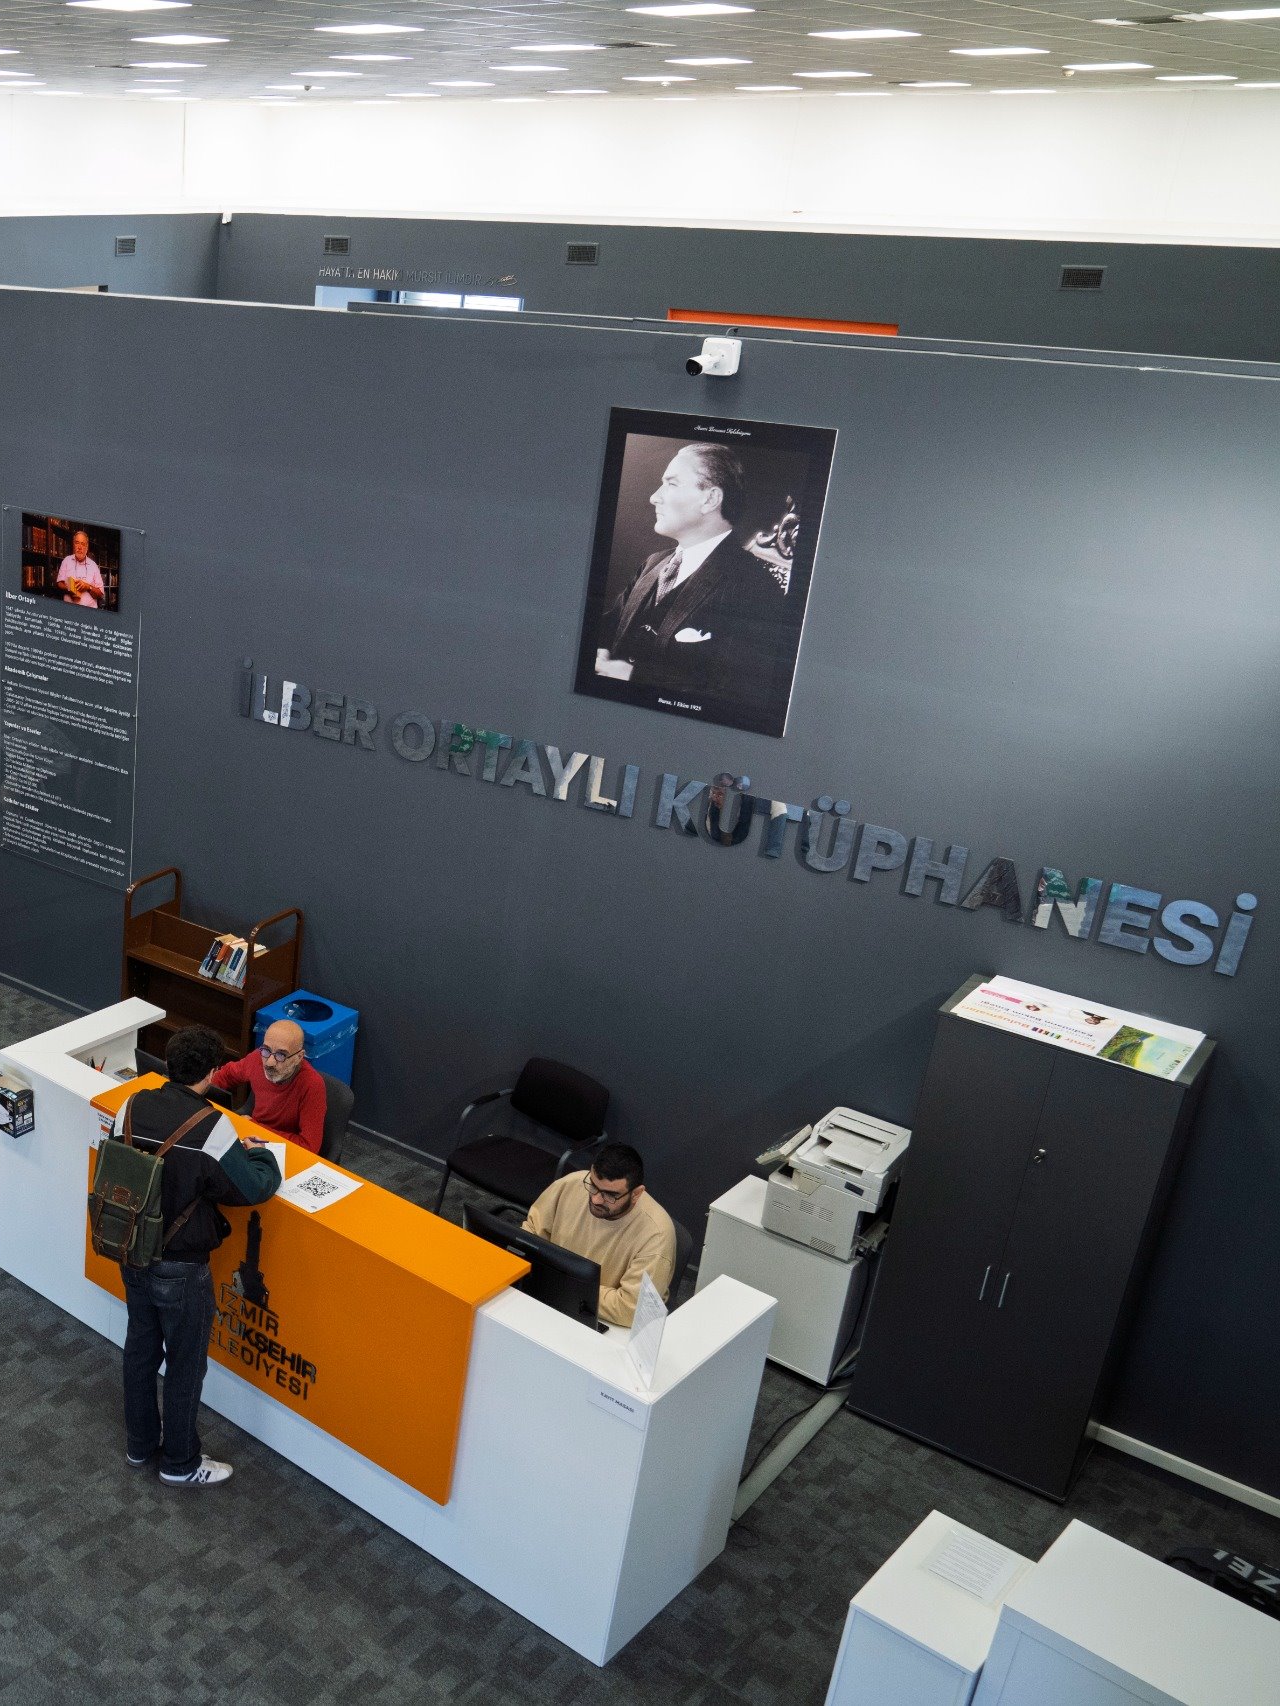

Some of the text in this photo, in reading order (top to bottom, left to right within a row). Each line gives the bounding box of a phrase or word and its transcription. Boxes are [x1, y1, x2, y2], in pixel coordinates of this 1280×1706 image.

[357, 268, 370, 279] EN
[239, 656, 378, 751] İLBER
[391, 709, 640, 819] ORTAYLI
[655, 772, 1257, 978] KÜTÜPHANESİ
